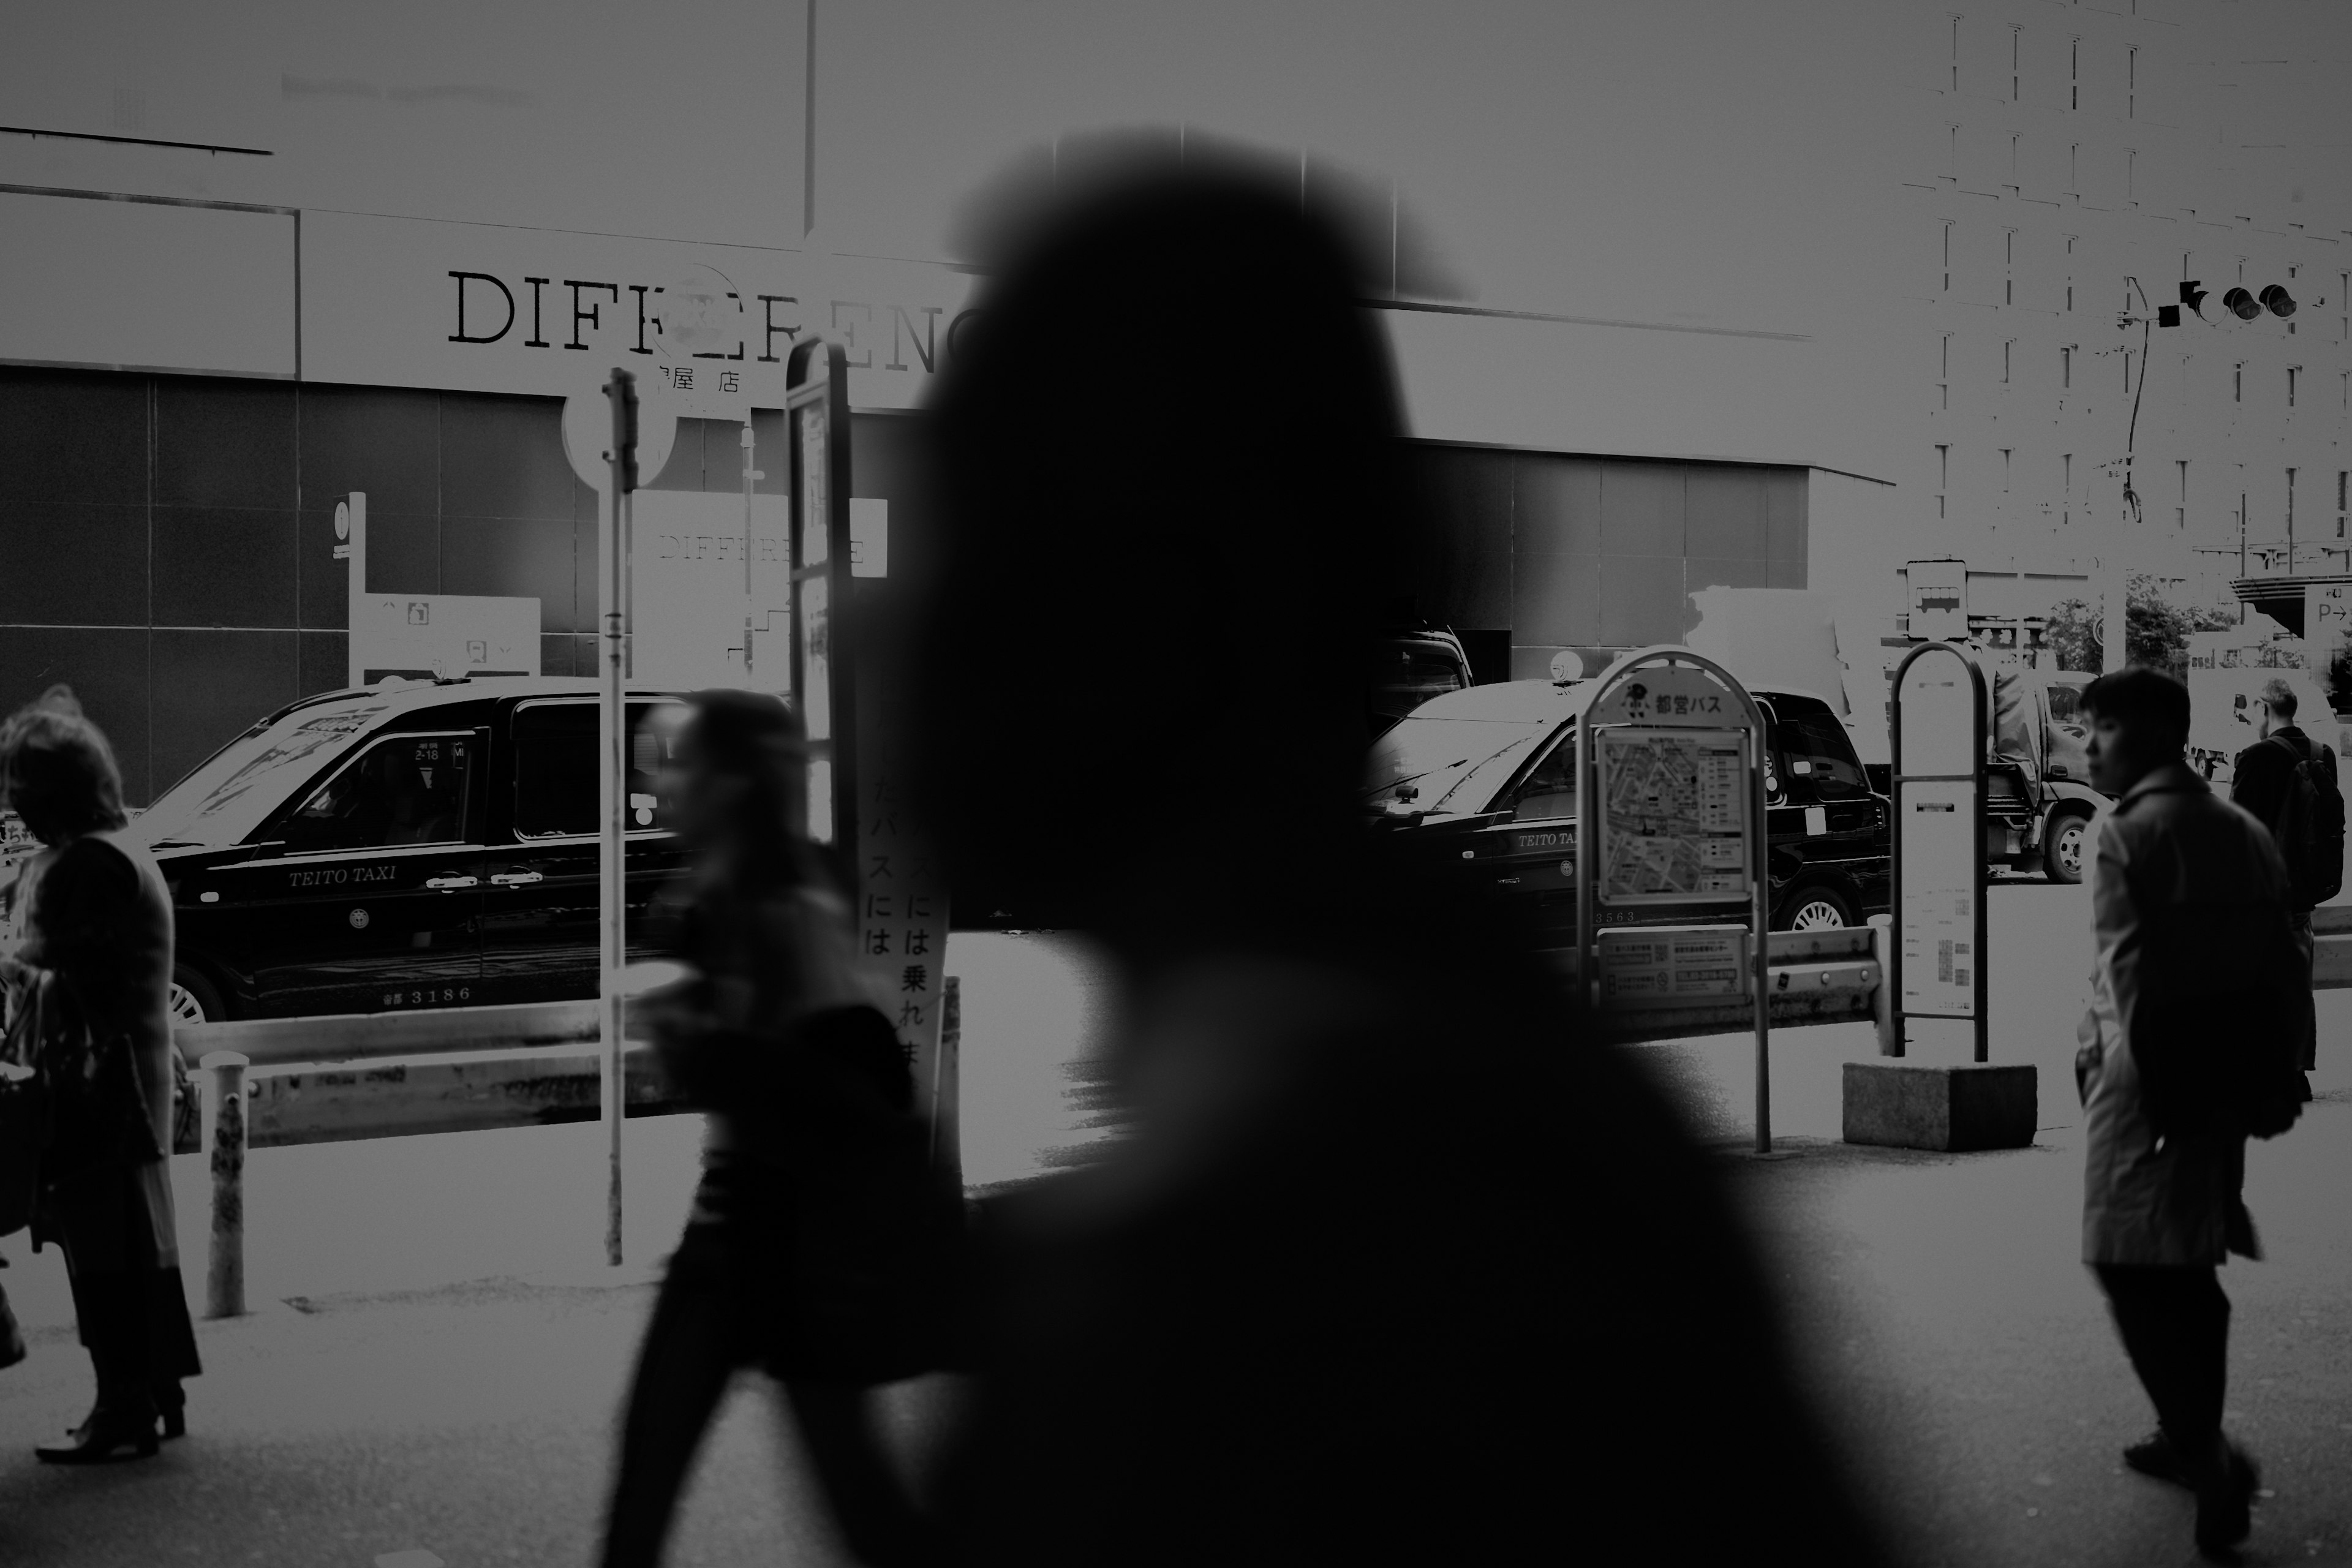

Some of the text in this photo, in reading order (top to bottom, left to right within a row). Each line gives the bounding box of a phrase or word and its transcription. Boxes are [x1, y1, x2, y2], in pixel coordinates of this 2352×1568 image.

[659, 365, 740, 393] 屋 店
[2319, 603, 2331, 622] P
[1656, 694, 1722, 715] 都営バス
[415, 750, 439, 761] 2-18
[1519, 833, 1557, 847] TEITO
[289, 865, 398, 888] TEITO TAXI
[1595, 911, 1635, 924] 3563
[411, 987, 470, 1005] 3186
